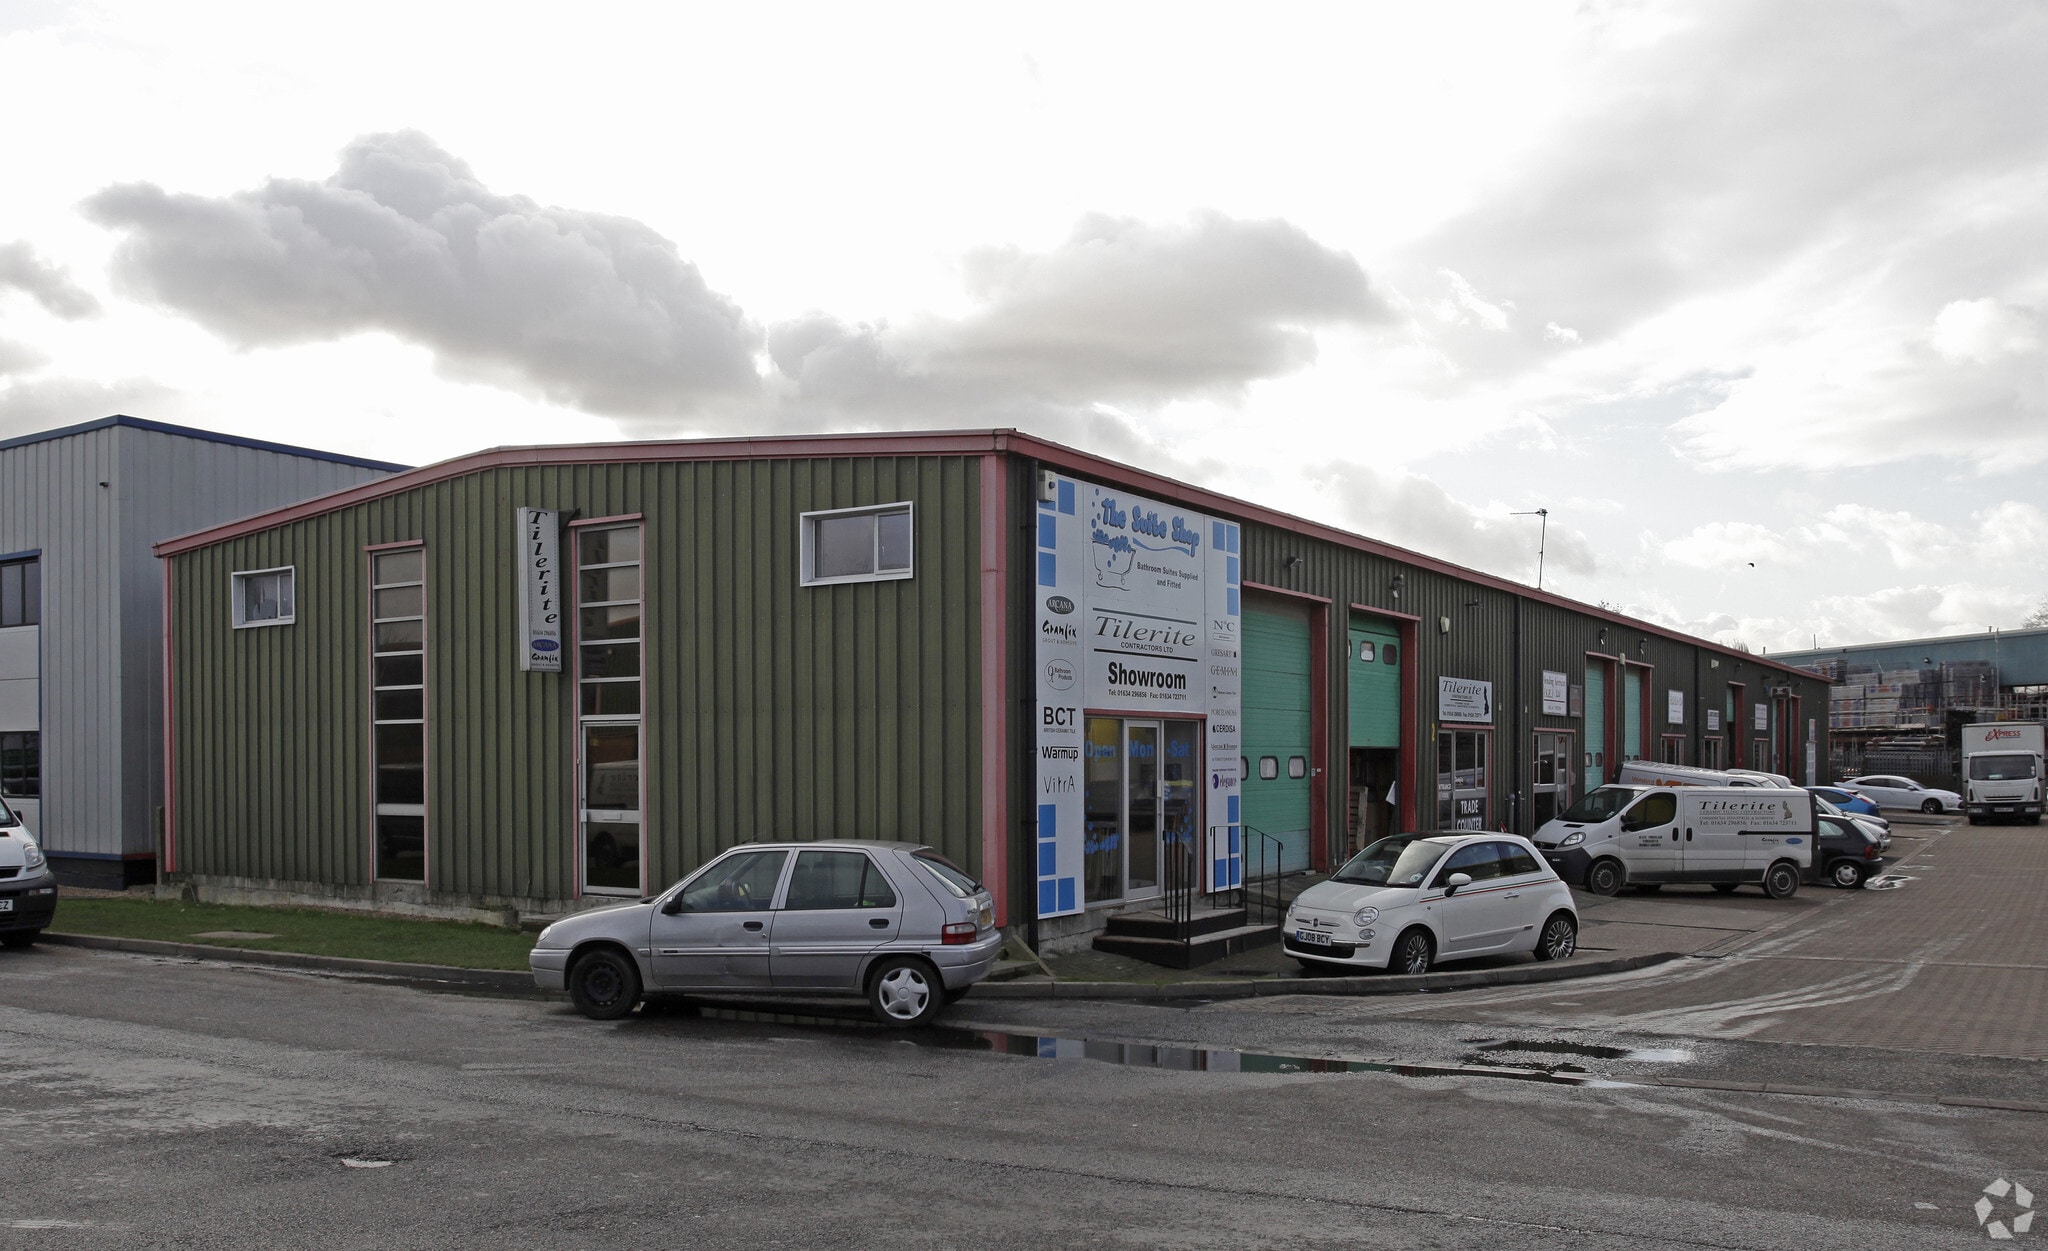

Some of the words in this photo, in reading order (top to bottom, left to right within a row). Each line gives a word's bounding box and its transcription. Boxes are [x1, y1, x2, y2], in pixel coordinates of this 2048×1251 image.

[1101, 498, 1127, 529] The
[1132, 505, 1167, 539] Suite
[1172, 516, 1200, 557] Shop
[529, 511, 558, 624] Tilerite
[1137, 562, 1162, 573] Bathroom
[1163, 567, 1178, 577] Suites
[1179, 570, 1199, 581] Supplied
[1167, 580, 1182, 589] Fitted
[1048, 599, 1073, 612] ARCANA
[1042, 620, 1077, 640] Granfix
[1094, 616, 1196, 647] Tilerite
[1121, 642, 1162, 652] CONTRACTORS
[1108, 661, 1187, 690] Showroom
[1443, 680, 1482, 696] Tilerite
[1043, 706, 1076, 726] BCT
[1042, 745, 1079, 762] Warmup
[1085, 740, 1117, 763] Open
[1128, 739, 1155, 758] Mon
[1043, 775, 1075, 794] VitrA
[1461, 800, 1479, 814] TRADE
[1699, 801, 1776, 810] Tilerite
[1457, 816, 1483, 831] COUNTER
[1300, 931, 1316, 942] GJ08
[1316, 934, 1329, 944] BCY
